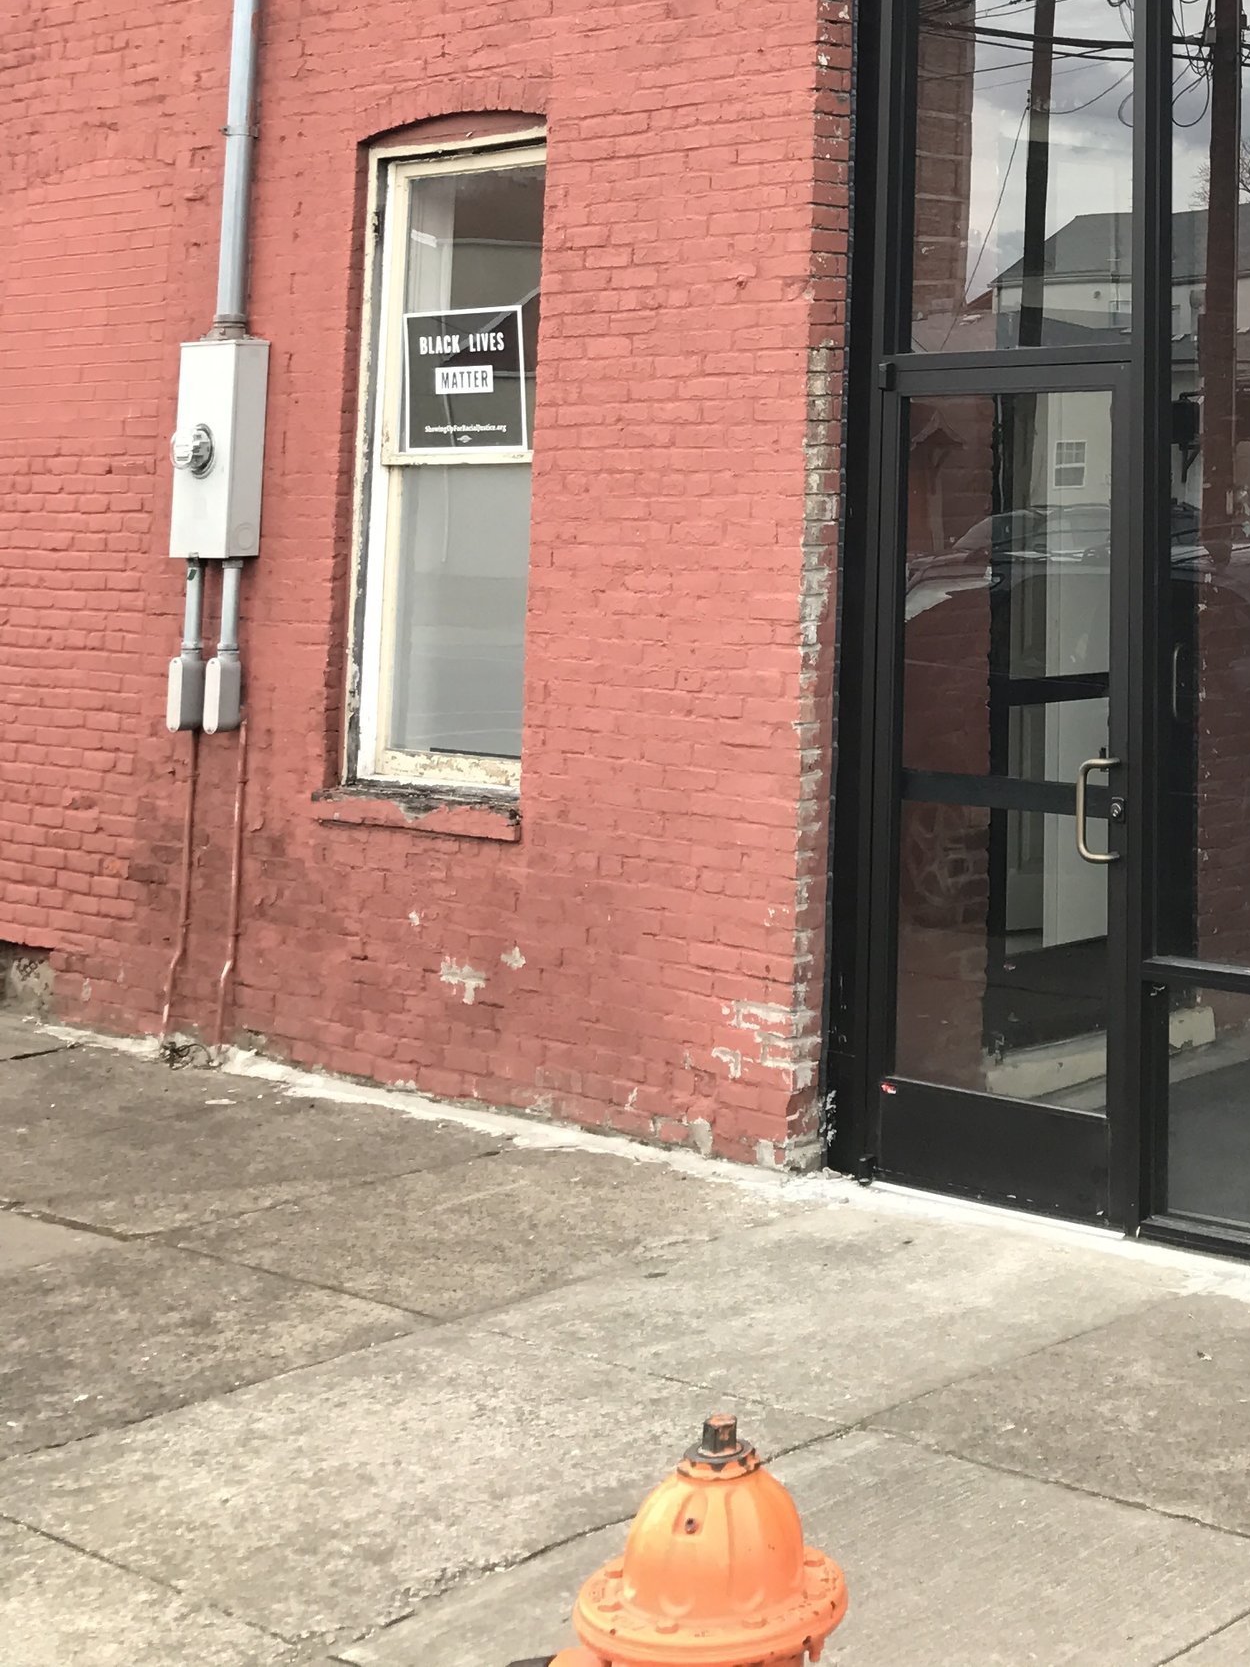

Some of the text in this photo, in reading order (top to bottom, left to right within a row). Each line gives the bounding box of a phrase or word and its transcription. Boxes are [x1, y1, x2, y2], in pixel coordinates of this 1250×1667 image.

[419, 332, 505, 355] BLACK LIVES
[441, 370, 488, 389] MATTER
[424, 424, 507, 434] ShowingUpForRacialJustice.org
